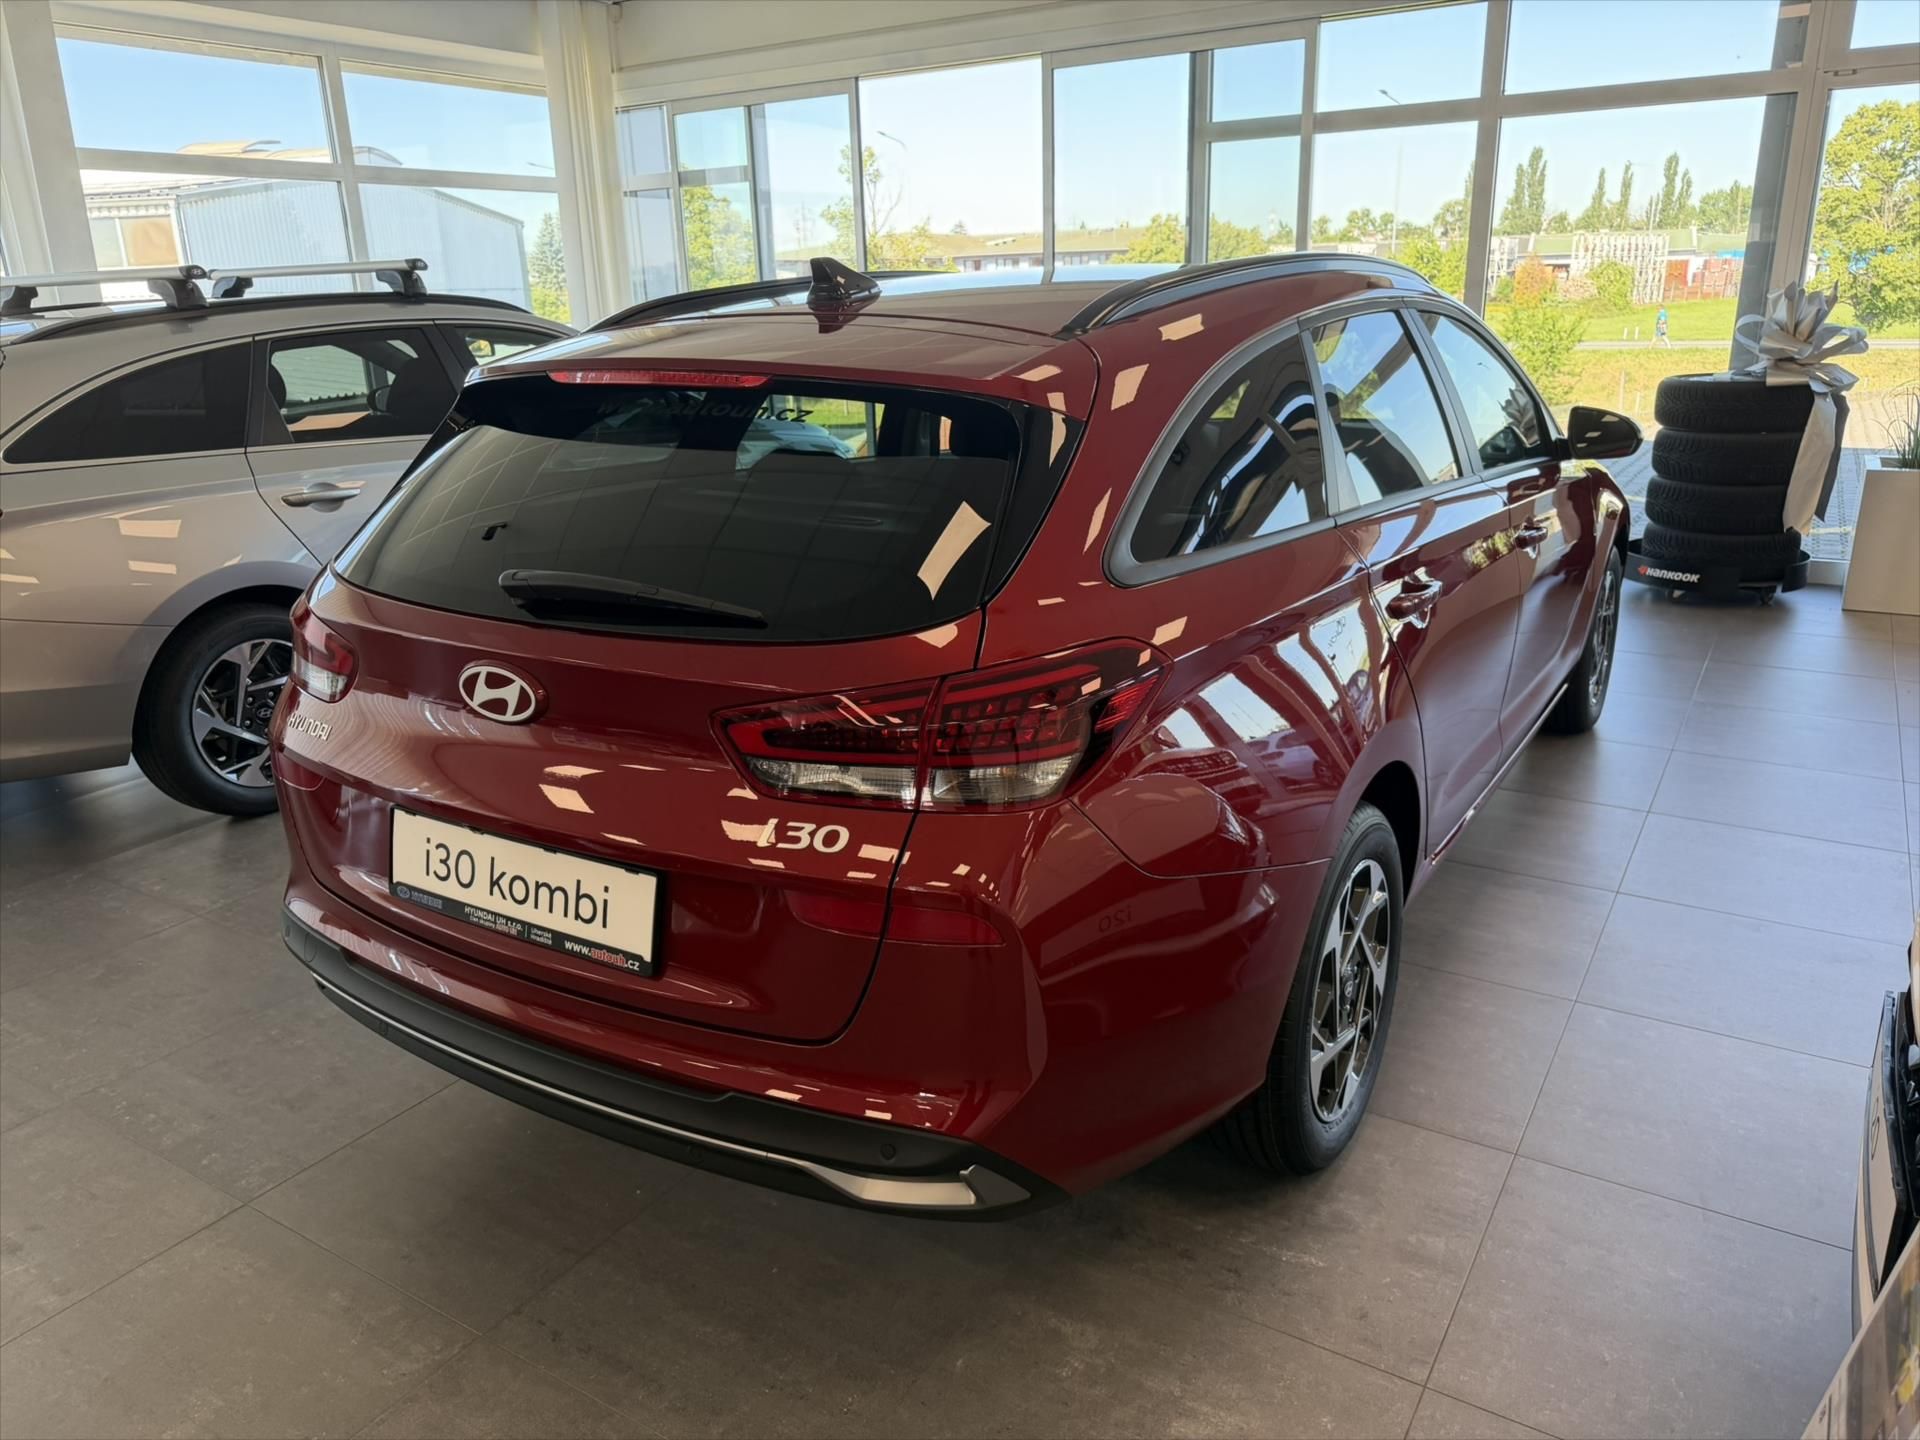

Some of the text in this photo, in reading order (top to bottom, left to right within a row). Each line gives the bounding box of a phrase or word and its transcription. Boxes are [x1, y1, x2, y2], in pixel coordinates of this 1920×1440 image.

[287, 712, 333, 741] HYUNDAI
[757, 818, 850, 853] i30
[425, 837, 609, 929] i30 kombi
[464, 904, 495, 922] HYUNDAI
[564, 940, 640, 971] www.autouh.cz
